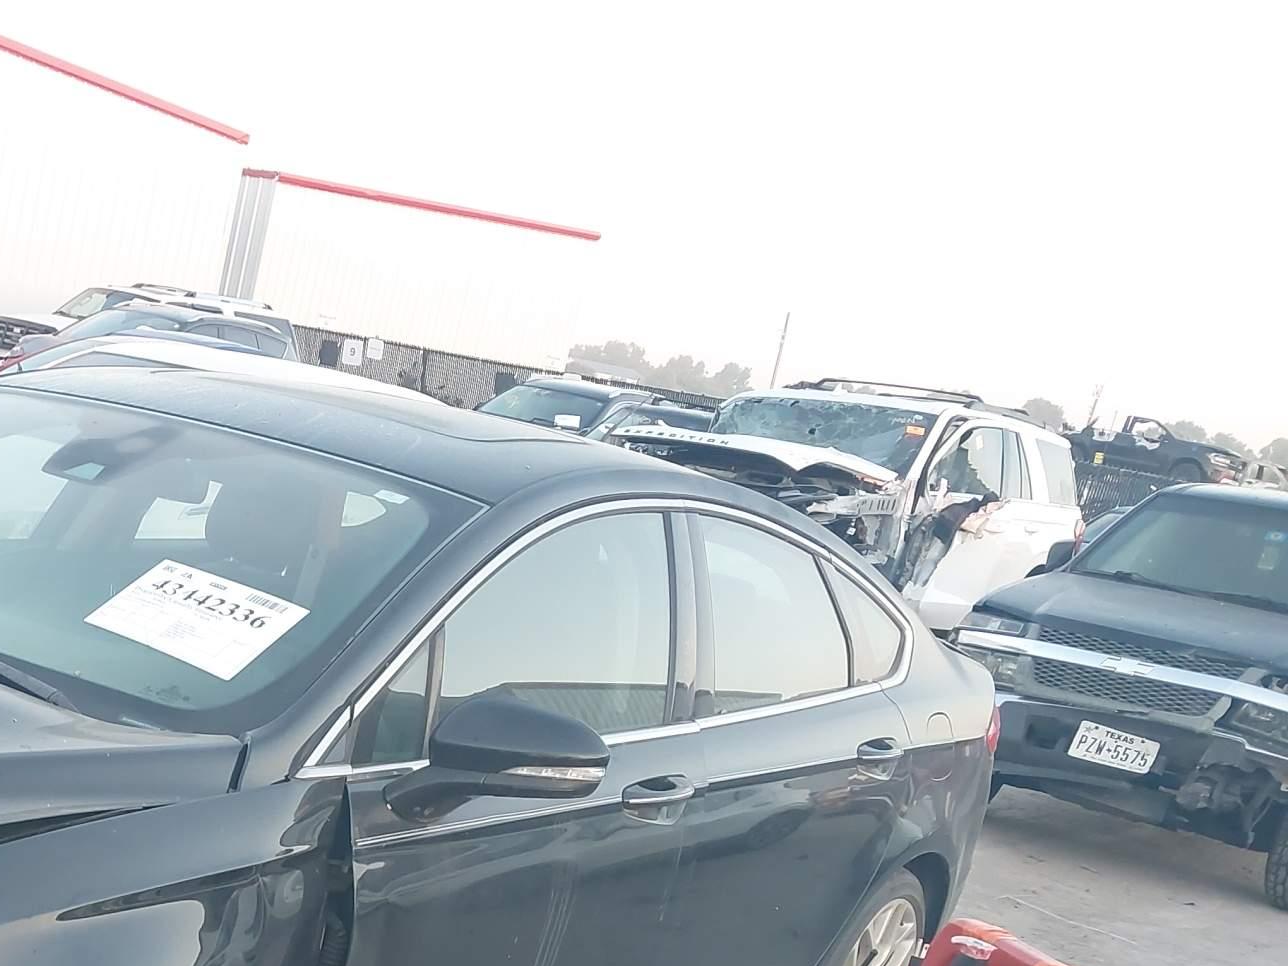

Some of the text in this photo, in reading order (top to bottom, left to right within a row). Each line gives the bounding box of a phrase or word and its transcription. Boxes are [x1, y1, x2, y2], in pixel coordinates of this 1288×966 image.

[623, 428, 730, 446] EXPEDITION
[152, 579, 271, 629] 43442336
[1104, 730, 1136, 745] TEXAS
